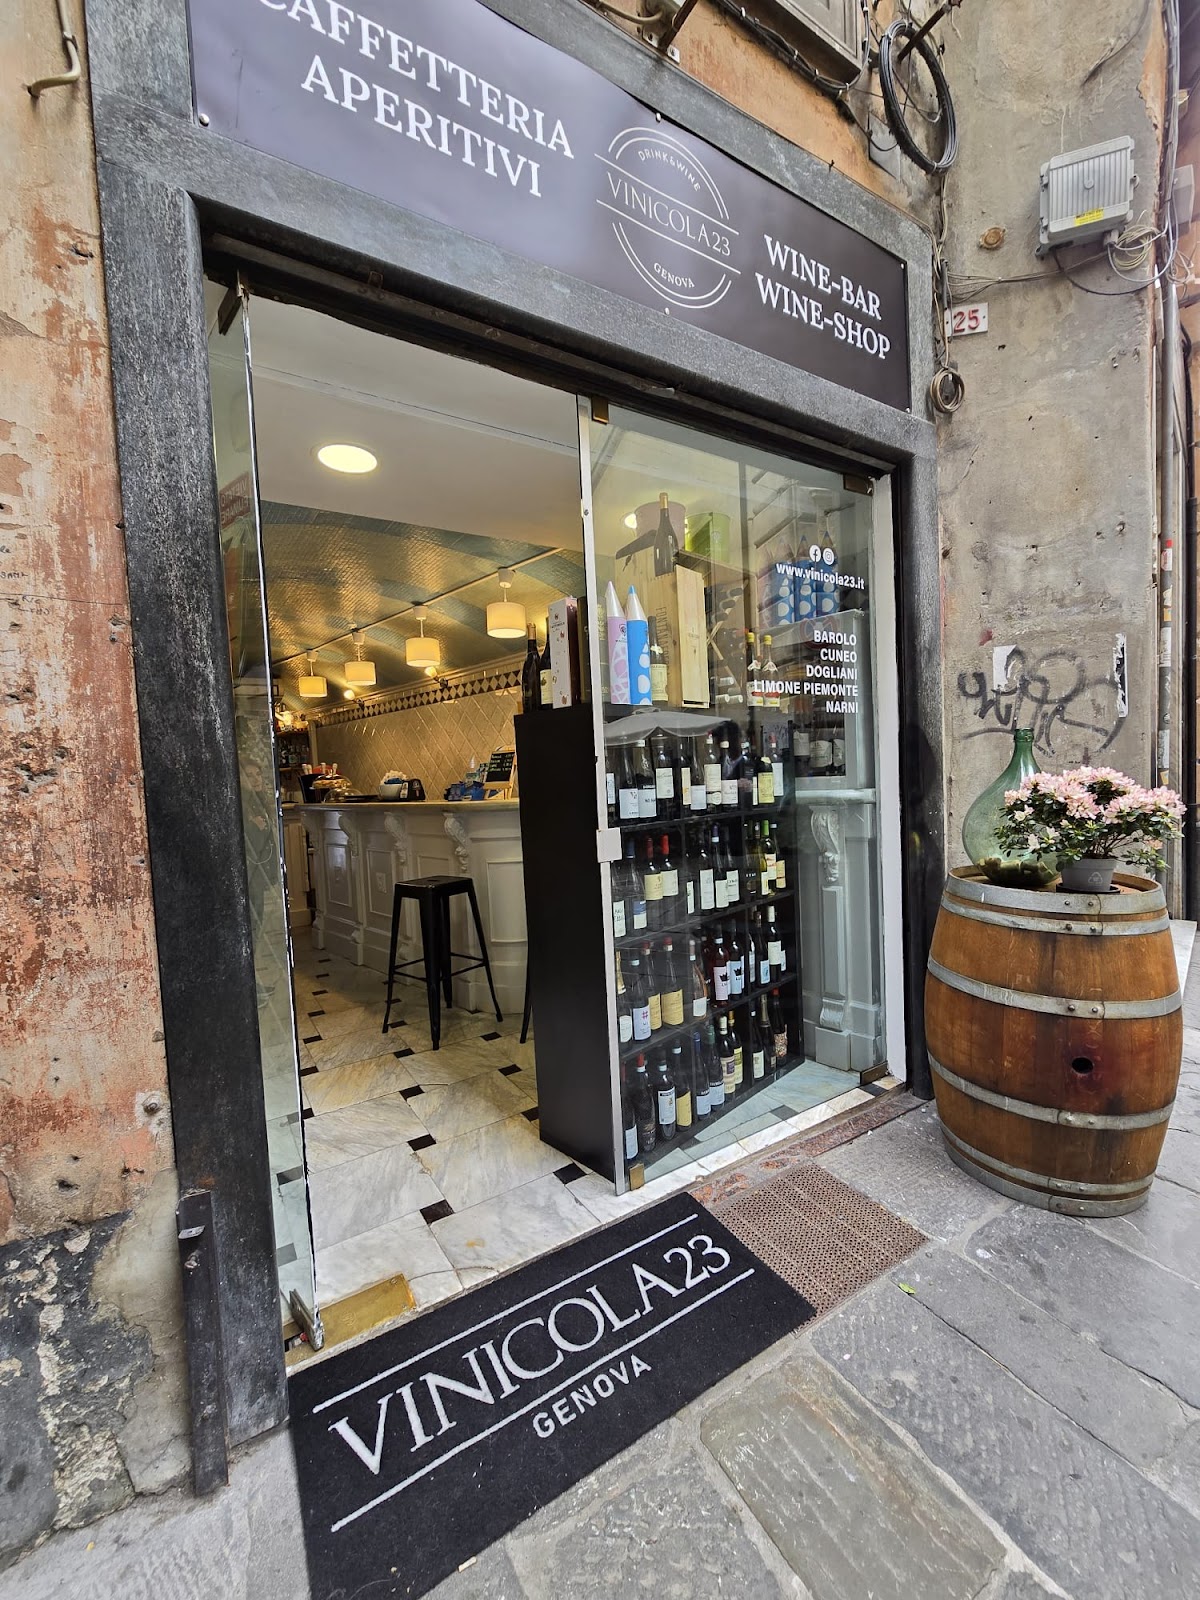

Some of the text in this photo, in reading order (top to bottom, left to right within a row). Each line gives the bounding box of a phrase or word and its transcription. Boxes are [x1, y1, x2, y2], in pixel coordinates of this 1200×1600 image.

[258, 0, 574, 159] AFFETTERIA
[301, 55, 541, 197] APERITIVI
[637, 147, 701, 192] DRINK&WINE
[607, 172, 731, 256] VINICOLA23
[653, 262, 696, 288] GENOVA
[764, 234, 882, 321] WINE-BAR
[755, 272, 890, 360] WINE-SHOP
[953, 308, 980, 333] 25
[776, 563, 865, 590] www.vinicola23.it
[814, 630, 857, 646] BAROLO
[820, 649, 858, 663] CUNEO
[754, 680, 801, 695] LIMONE
[803, 682, 859, 697] PIEMONTE
[806, 664, 858, 680] DOGLIANI
[826, 700, 859, 713] NARNI
[328, 1234, 731, 1475] VINICOLA23
[532, 1354, 652, 1439] GENOVA
